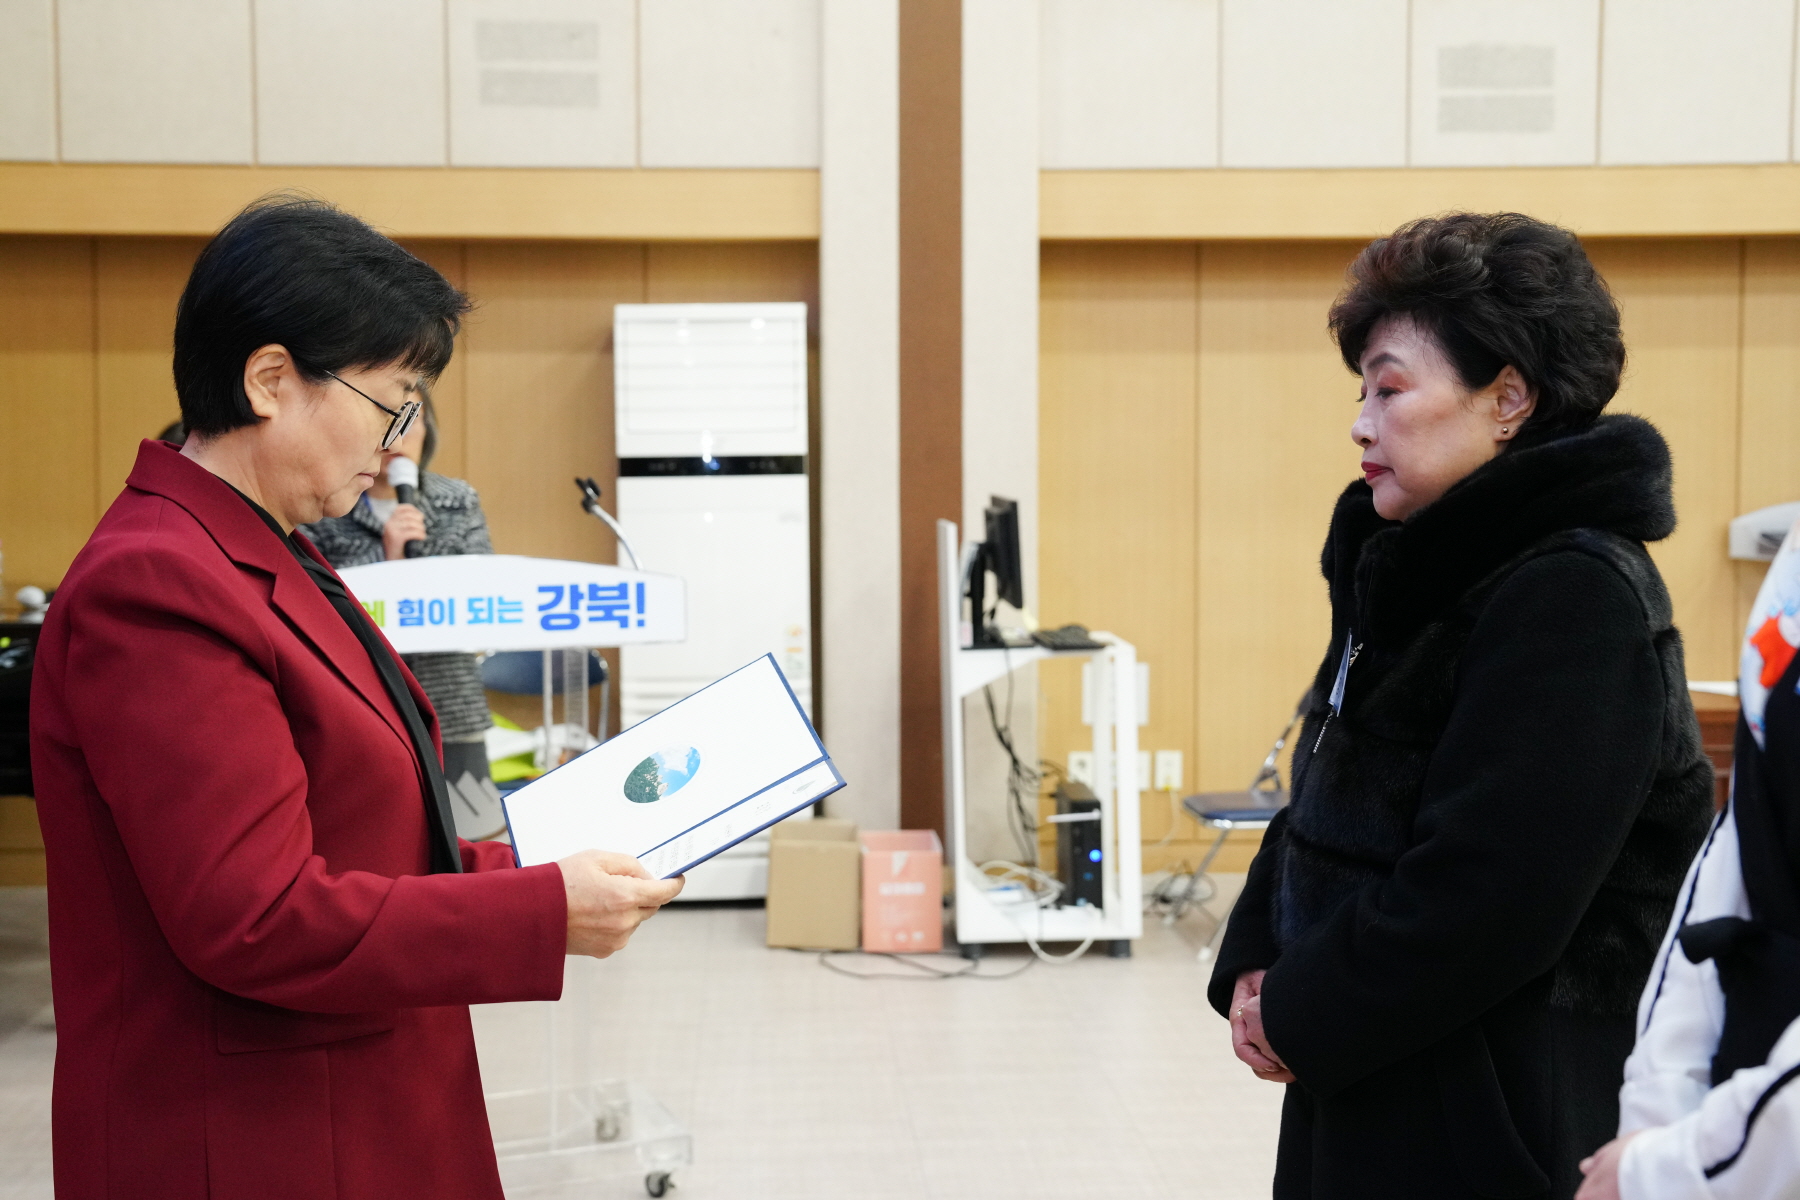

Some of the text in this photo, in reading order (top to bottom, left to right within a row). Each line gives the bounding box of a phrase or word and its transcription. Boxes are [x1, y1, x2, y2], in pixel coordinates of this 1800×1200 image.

[398, 598, 455, 627] 힘이
[467, 596, 524, 624] 되는
[537, 582, 646, 631] 강북!
